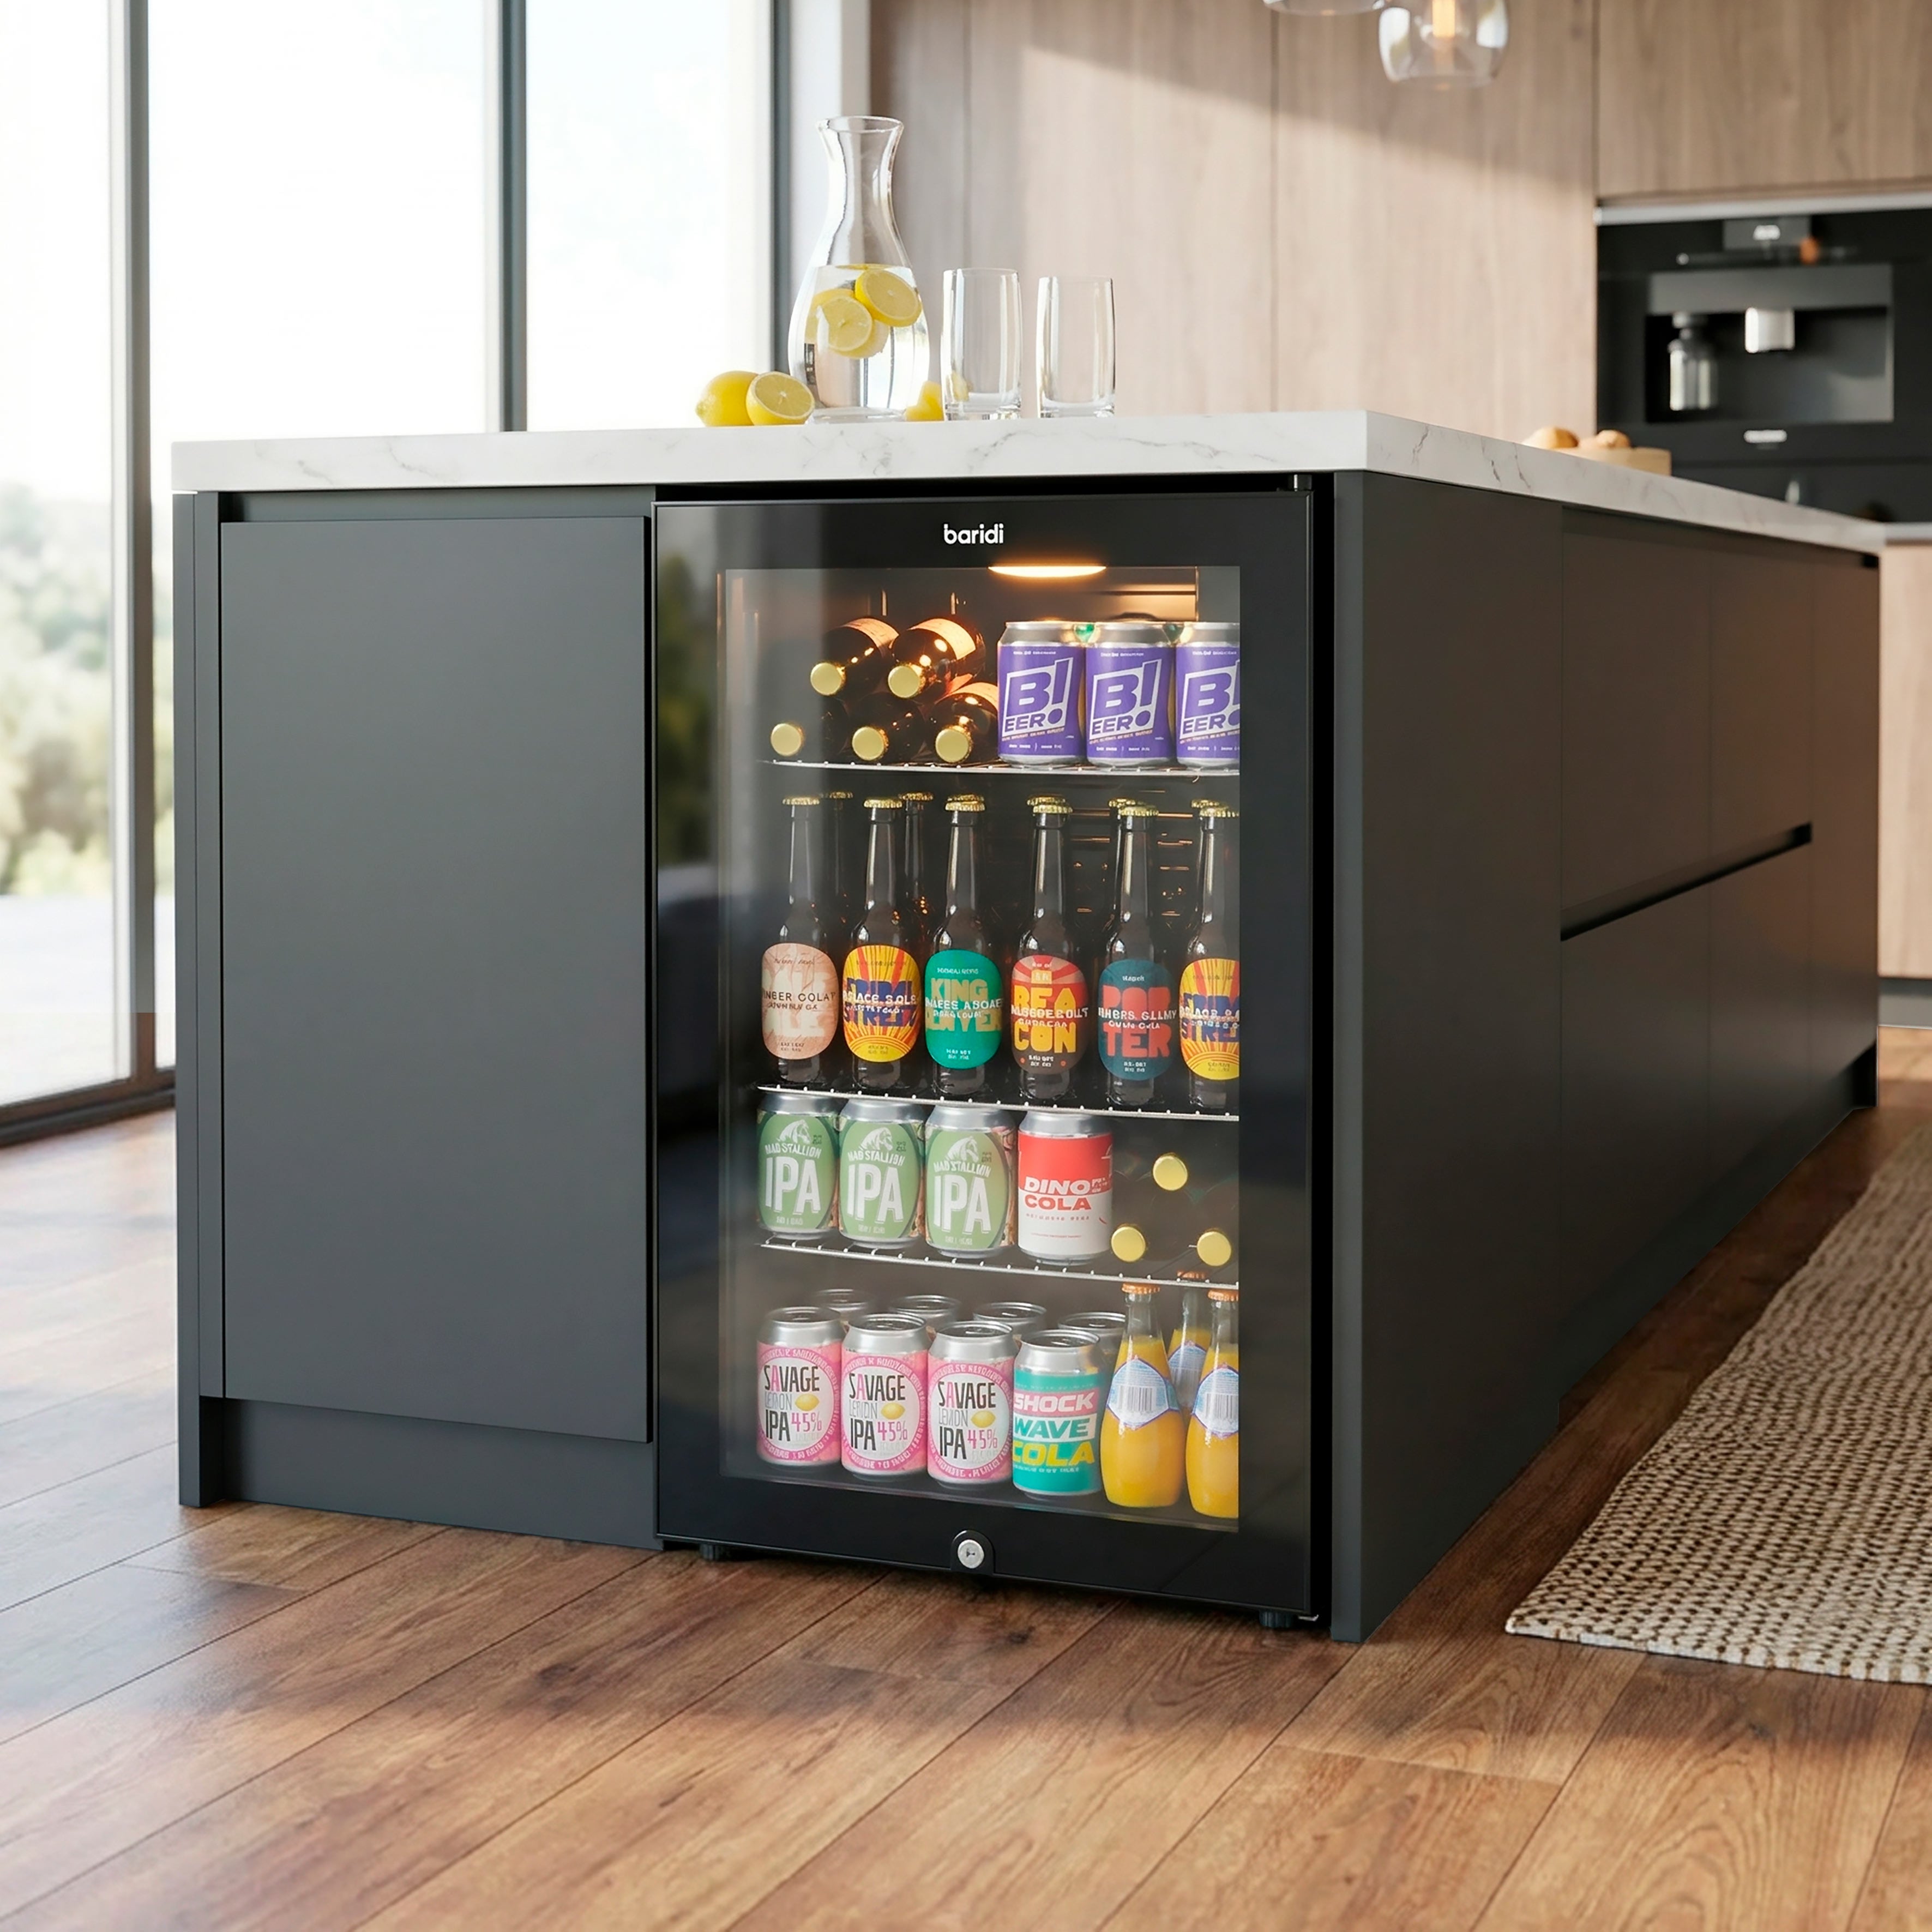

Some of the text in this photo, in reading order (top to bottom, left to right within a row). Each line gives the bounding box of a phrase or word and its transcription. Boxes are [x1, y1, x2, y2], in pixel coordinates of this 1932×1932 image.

[943, 523, 1004, 544] baridi
[931, 978, 988, 1002] KING
[1103, 1021, 1172, 1058] TER
[765, 1157, 821, 1214] IPA
[846, 1163, 904, 1223] IPA
[1024, 1176, 1091, 1195] DINO
[934, 1174, 991, 1233] IPA
[1025, 1194, 1092, 1211] COLA
[763, 1365, 820, 1392] SAVAGE
[848, 1373, 906, 1401] SAVAGE
[937, 1381, 996, 1409] SAVAGE
[1014, 1392, 1095, 1413] SHOCK
[766, 1409, 791, 1442] IPA
[851, 1418, 877, 1451] IPA
[1015, 1417, 1090, 1439] WAVE
[940, 1426, 967, 1460] IPA
[1013, 1441, 1095, 1467] COLA
